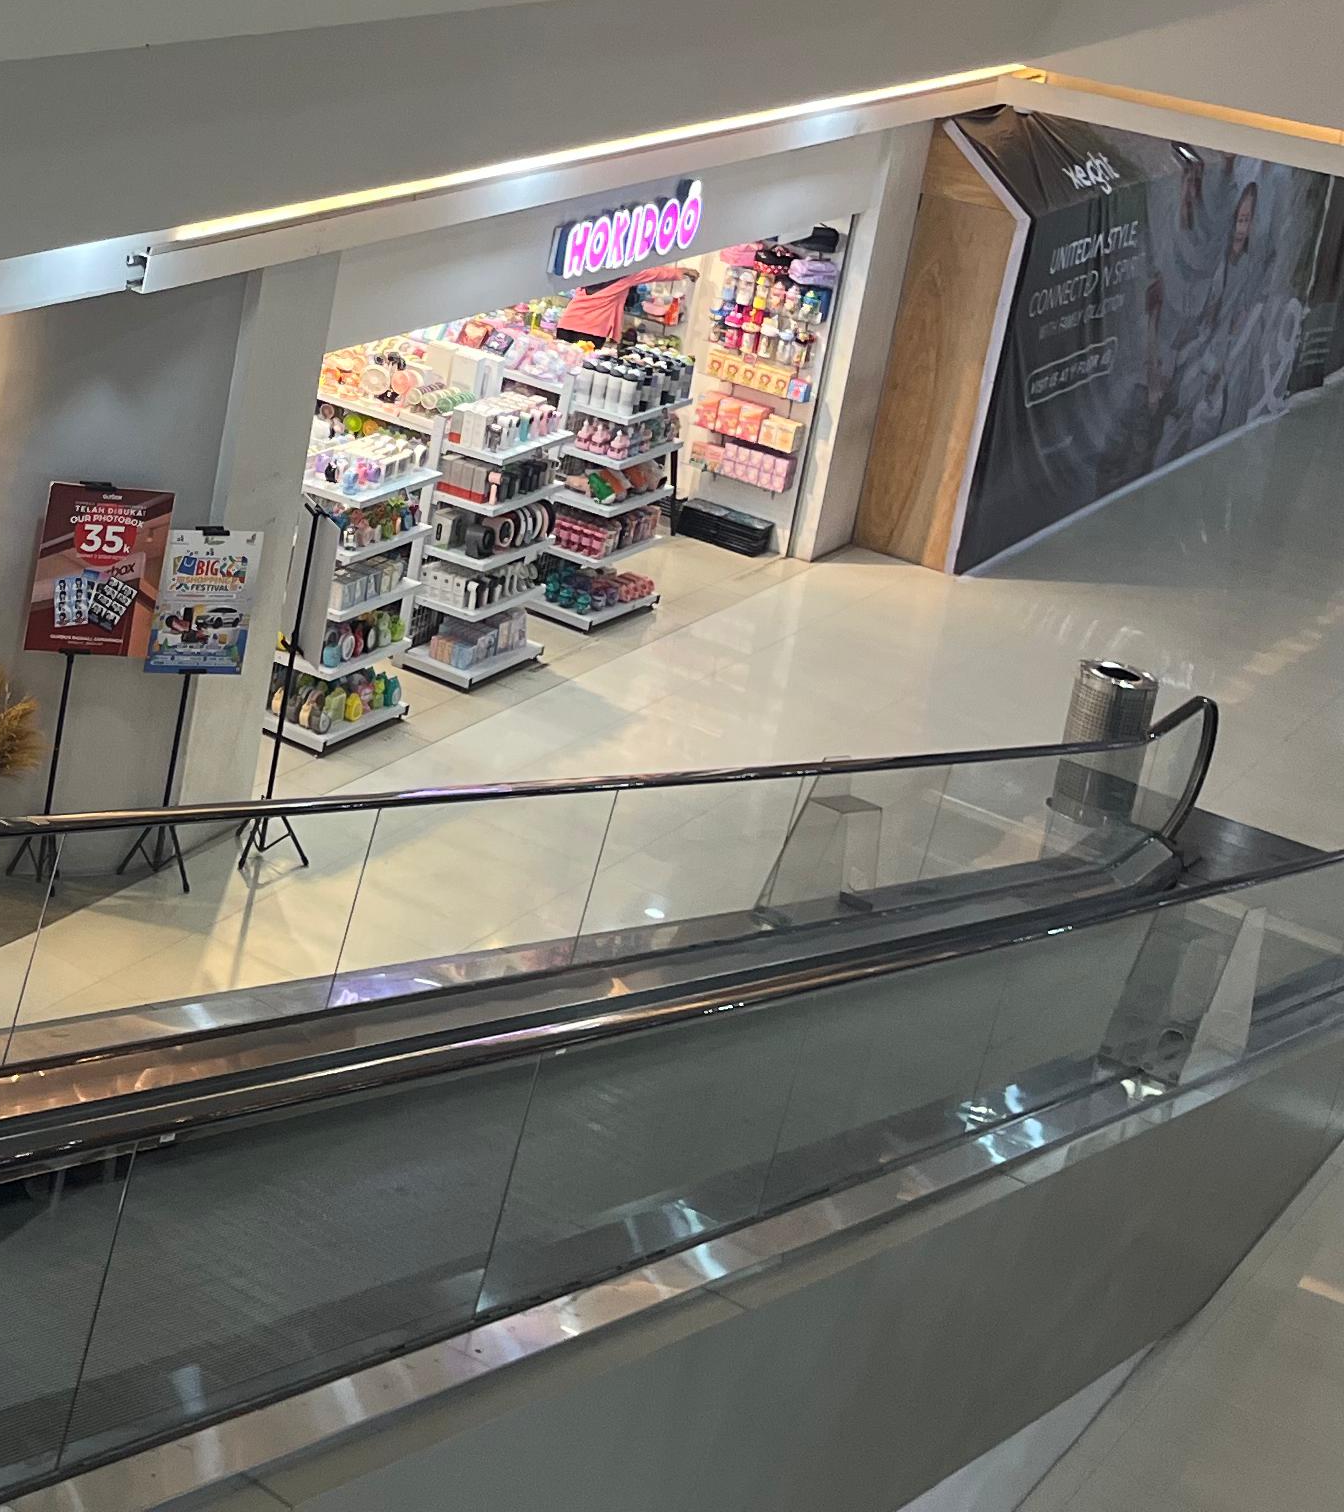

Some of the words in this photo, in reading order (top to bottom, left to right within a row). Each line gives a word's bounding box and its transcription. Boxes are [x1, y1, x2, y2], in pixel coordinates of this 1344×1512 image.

[562, 182, 702, 279] HOKIDOO
[108, 507, 147, 517] DIBUKA!
[70, 515, 91, 524] OUR
[93, 514, 144, 528] PHOTOBOX
[196, 559, 220, 576] BIG
[190, 583, 229, 592] FESTIVAL
